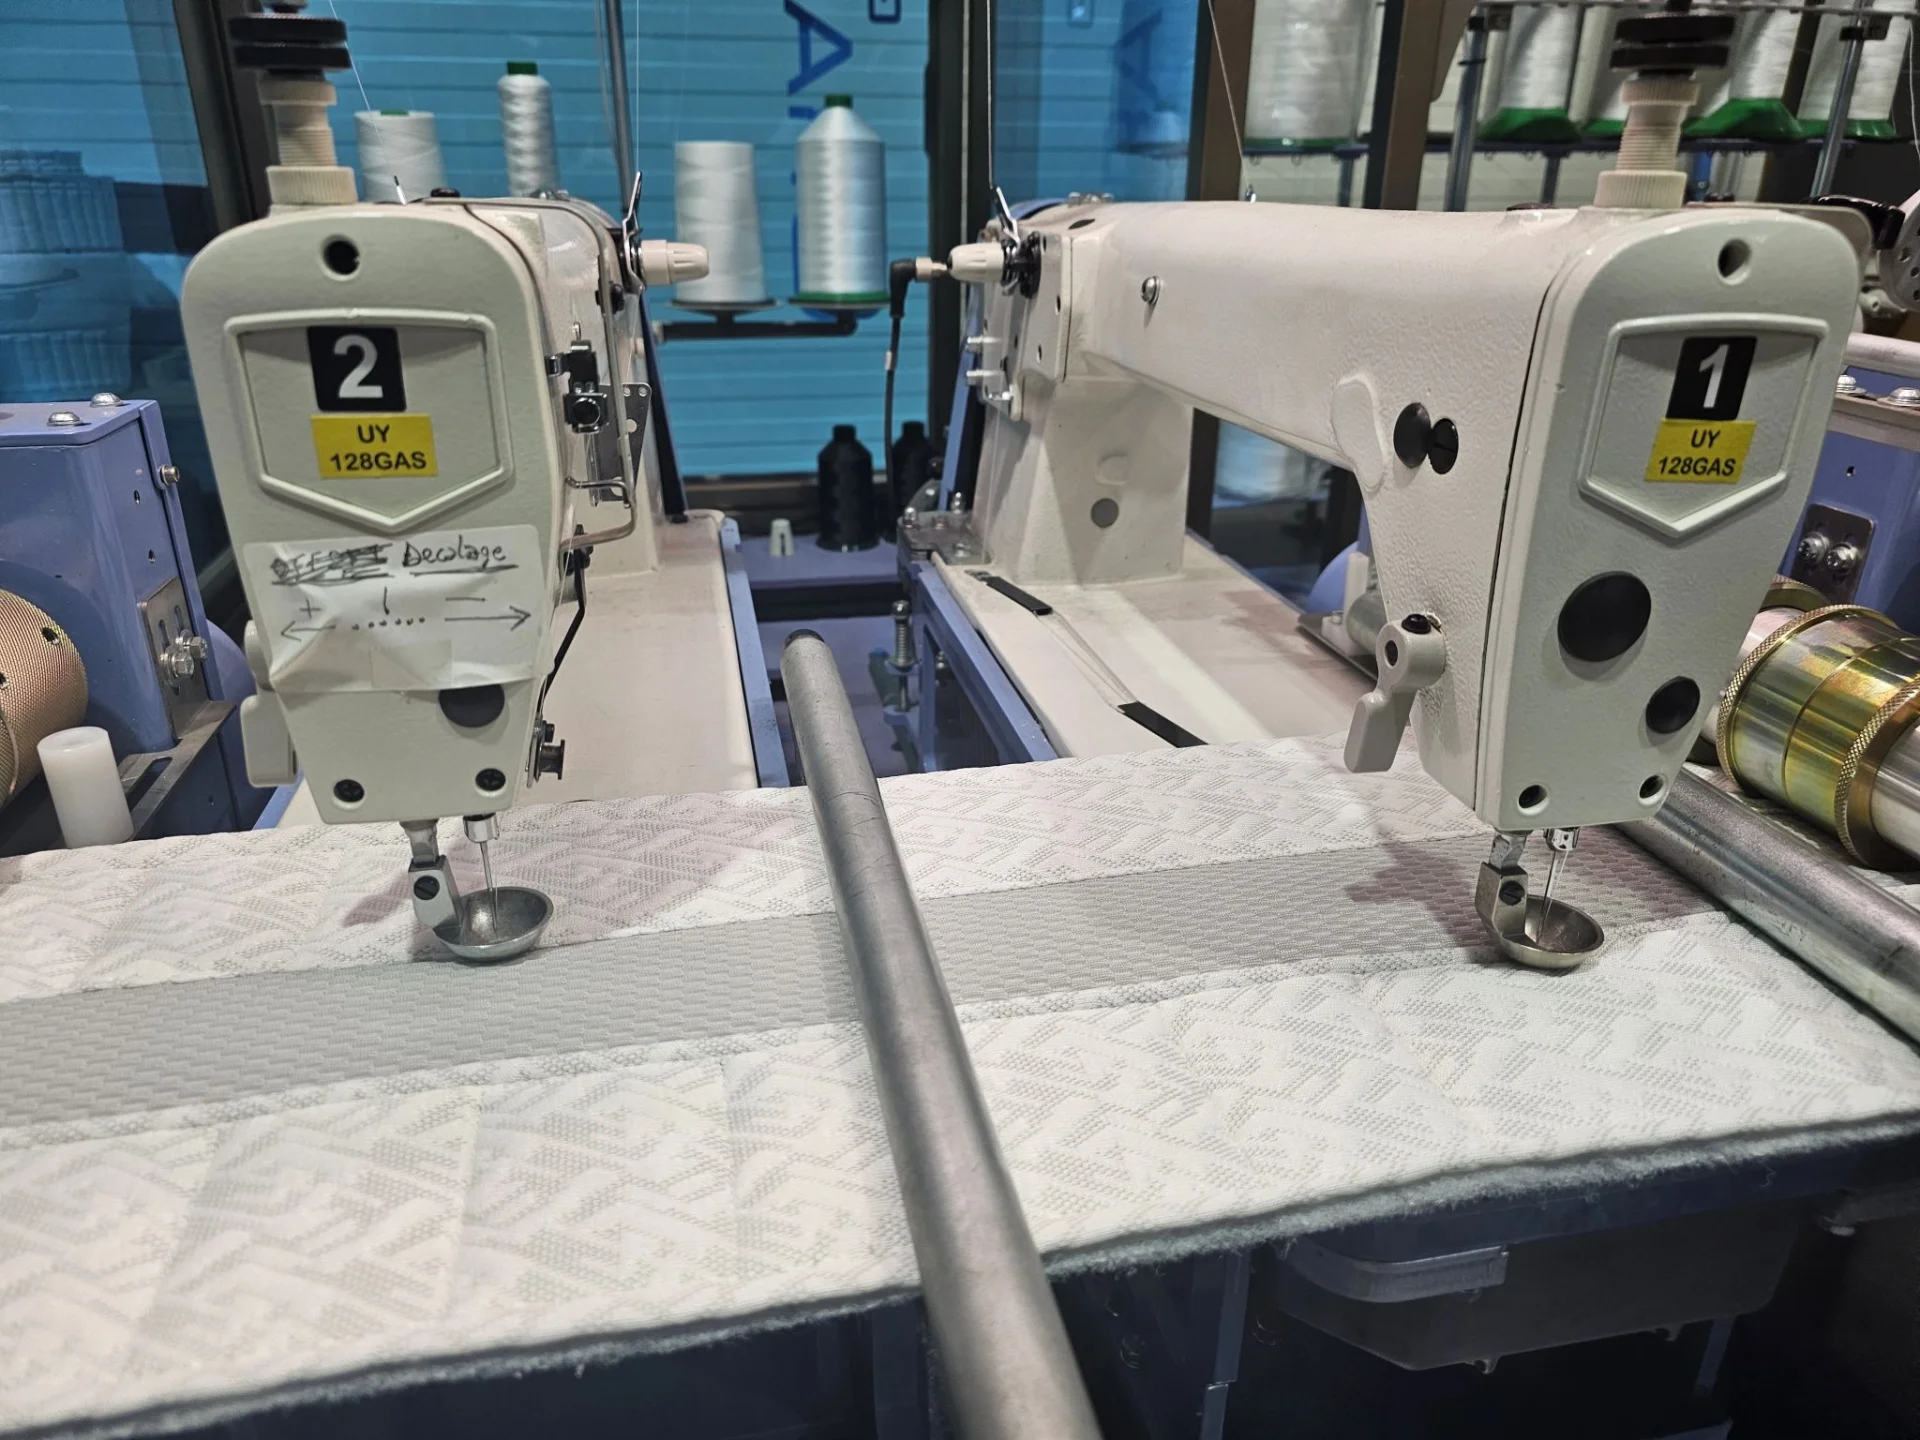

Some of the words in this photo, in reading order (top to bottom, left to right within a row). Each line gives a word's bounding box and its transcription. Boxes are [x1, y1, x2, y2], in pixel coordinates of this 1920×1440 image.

[333, 333, 384, 399] 2
[1699, 343, 1730, 409] 1
[357, 424, 390, 444] UY
[1690, 428, 1721, 449] UY
[330, 450, 427, 472] 128GAS
[1658, 456, 1737, 477] 128GAS
